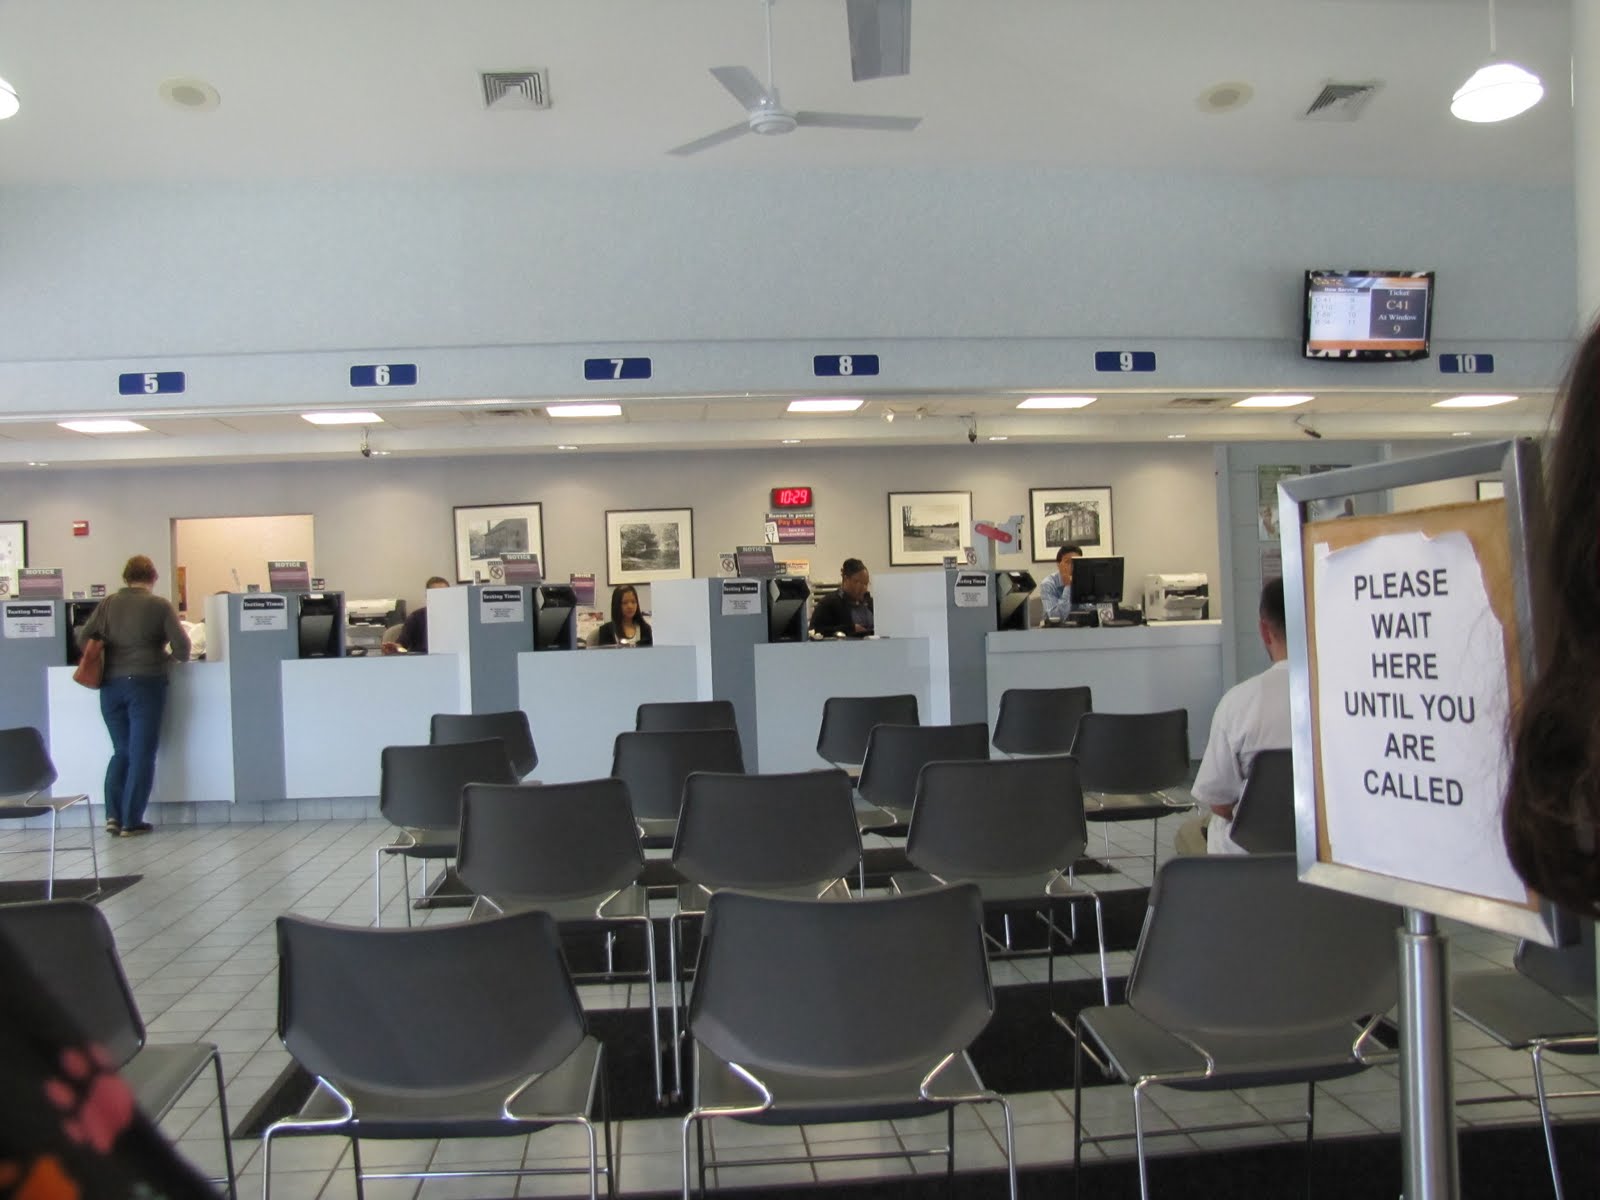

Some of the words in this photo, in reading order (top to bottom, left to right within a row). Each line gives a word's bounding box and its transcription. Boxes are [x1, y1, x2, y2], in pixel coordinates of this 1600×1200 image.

[1386, 300, 1409, 310] C41
[1393, 324, 1401, 335] 9
[610, 359, 624, 379] 7
[839, 356, 853, 375] 8
[1119, 352, 1134, 371] 9
[1456, 354, 1476, 373] 10
[143, 373, 158, 394] 5
[375, 366, 391, 386] 6
[780, 489, 808, 505] 10:29
[1354, 568, 1449, 600] PLEASE
[1371, 611, 1432, 639] WAIT
[1372, 653, 1439, 680] HERE
[1344, 691, 1414, 720] UNTIL
[1420, 694, 1476, 724] YOU
[1384, 733, 1436, 763] ARE
[1363, 769, 1464, 806] CALLED
